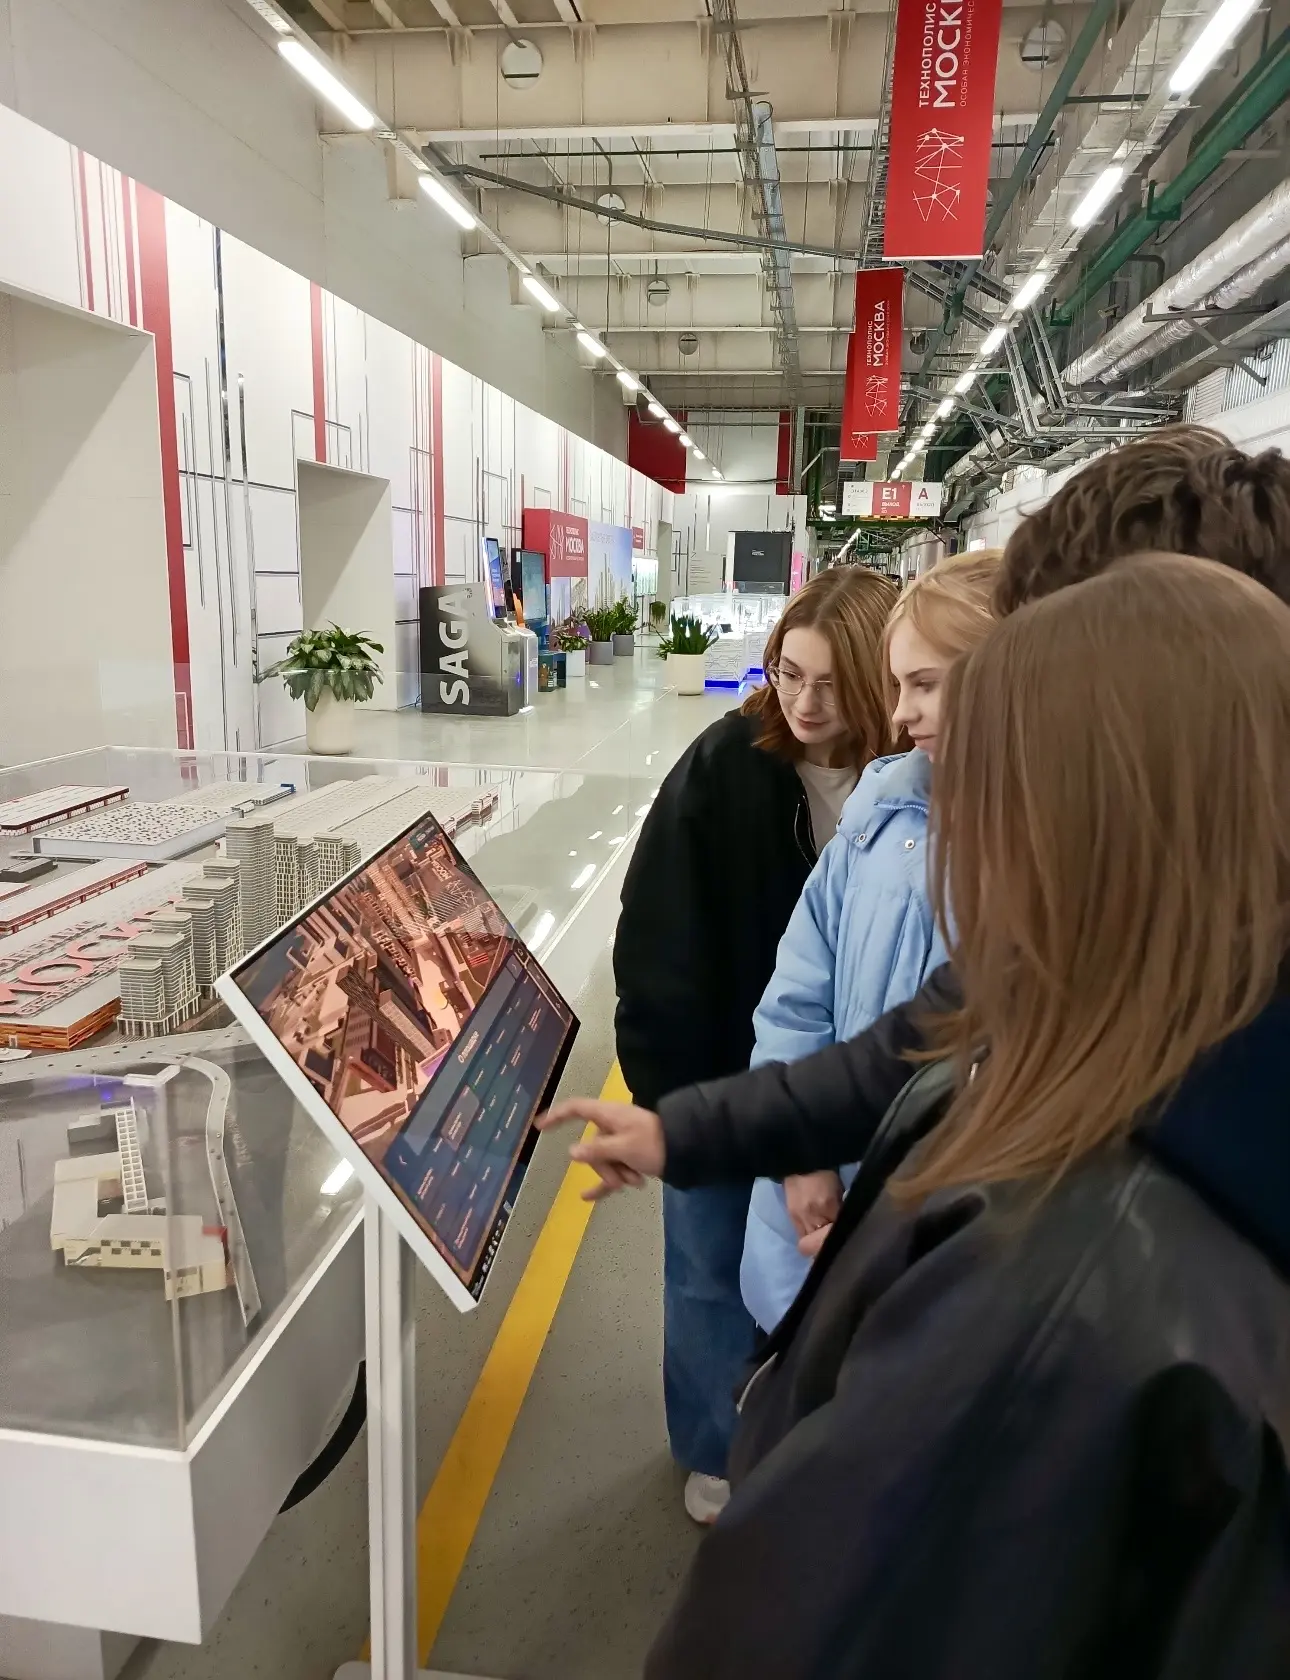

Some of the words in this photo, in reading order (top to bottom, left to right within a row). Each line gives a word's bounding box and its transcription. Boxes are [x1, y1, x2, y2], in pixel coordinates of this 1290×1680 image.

[919, 2, 936, 108] ТЕХНОПОЛИС
[959, 69, 969, 107] ОСОБАЯ
[872, 300, 886, 367] МОСКВА
[437, 589, 470, 706] SAGA
